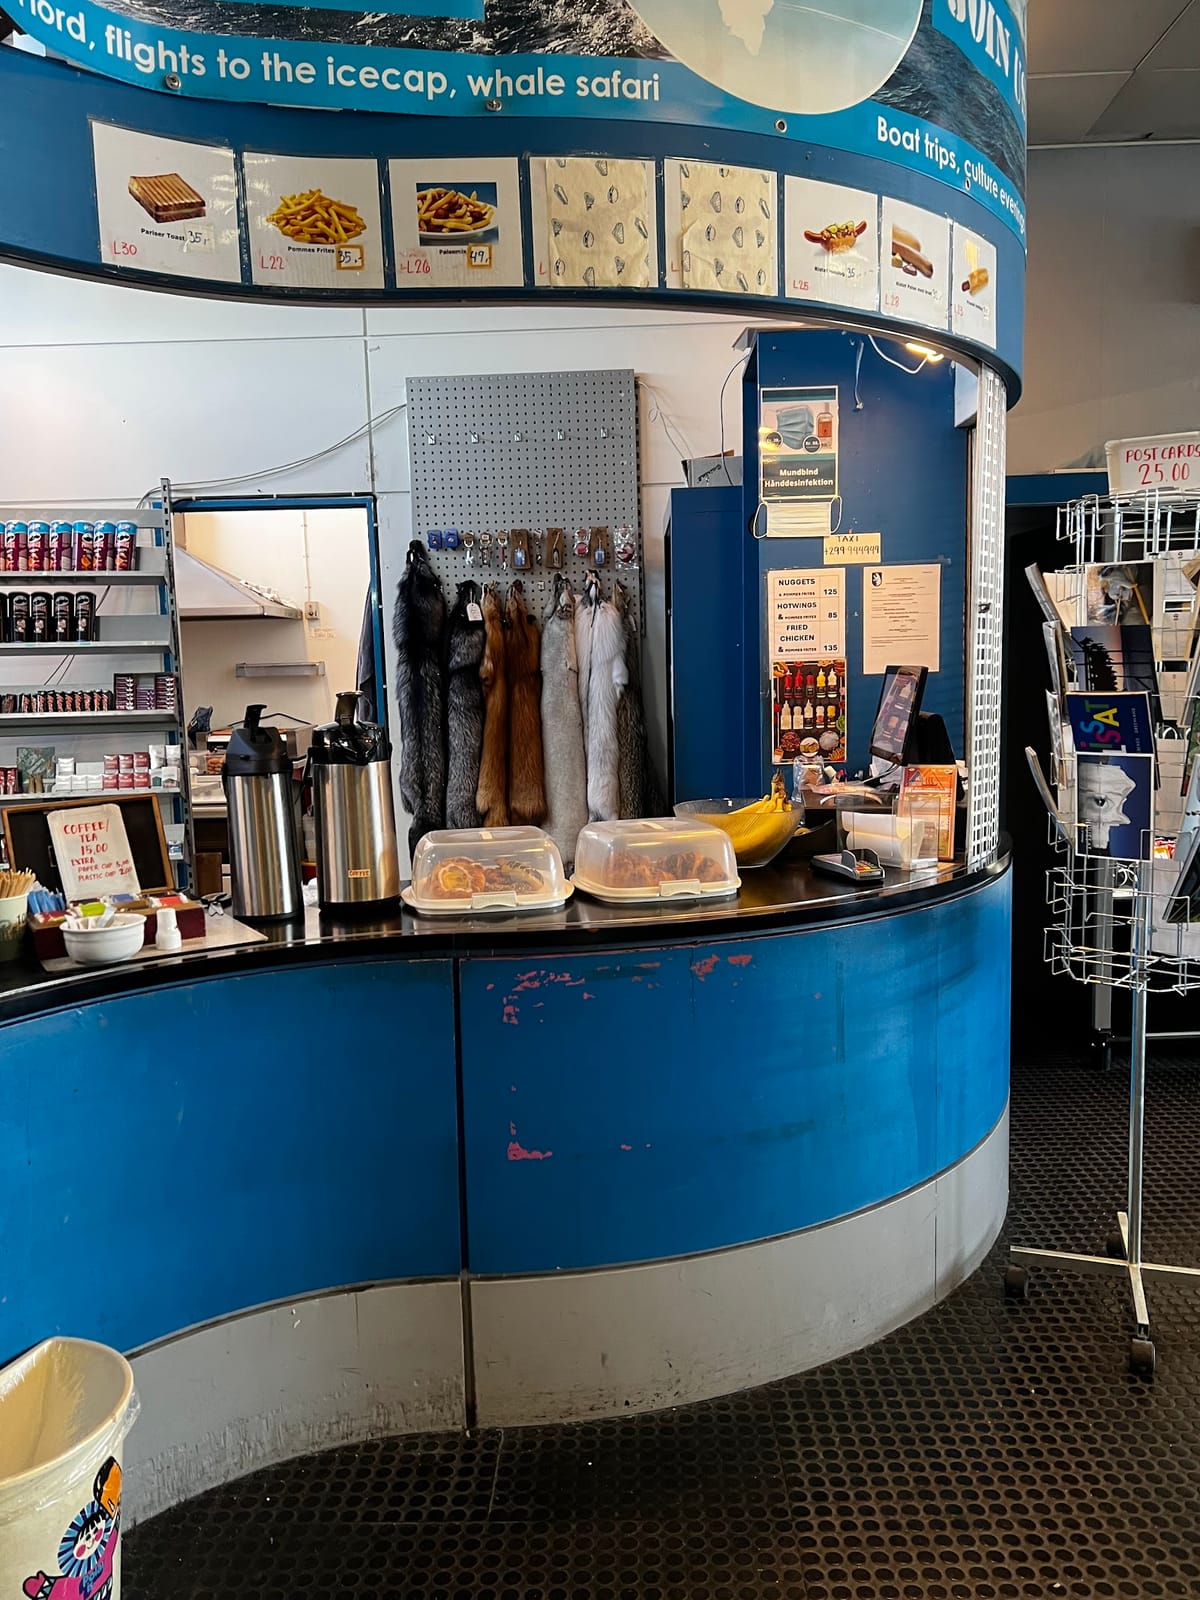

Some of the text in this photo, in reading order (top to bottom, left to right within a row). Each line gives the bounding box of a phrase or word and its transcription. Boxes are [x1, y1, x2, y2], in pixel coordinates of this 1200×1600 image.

[104, 24, 207, 76] flights
[216, 49, 251, 79] to
[261, 51, 317, 84] the
[326, 56, 457, 100] icecap,
[467, 67, 566, 97] whale
[576, 70, 660, 101] safari
[877, 115, 921, 153] Boat
[924, 133, 960, 174] trips,
[964, 160, 998, 199] culture
[140, 228, 185, 241] Pariser Toast
[112, 240, 138, 256] L30
[261, 255, 285, 270] L22
[779, 467, 819, 476] Mundbind
[764, 478, 834, 488] Hånddesinfektion
[837, 535, 859, 543] TAXI
[778, 578, 816, 586] NUGGETS
[779, 634, 815, 642] CHICKEN
[80, 832, 98, 843] TEA
[70, 857, 95, 867] EXTRA
[77, 864, 99, 873] PAPER
[78, 872, 103, 882] PLASTIC
